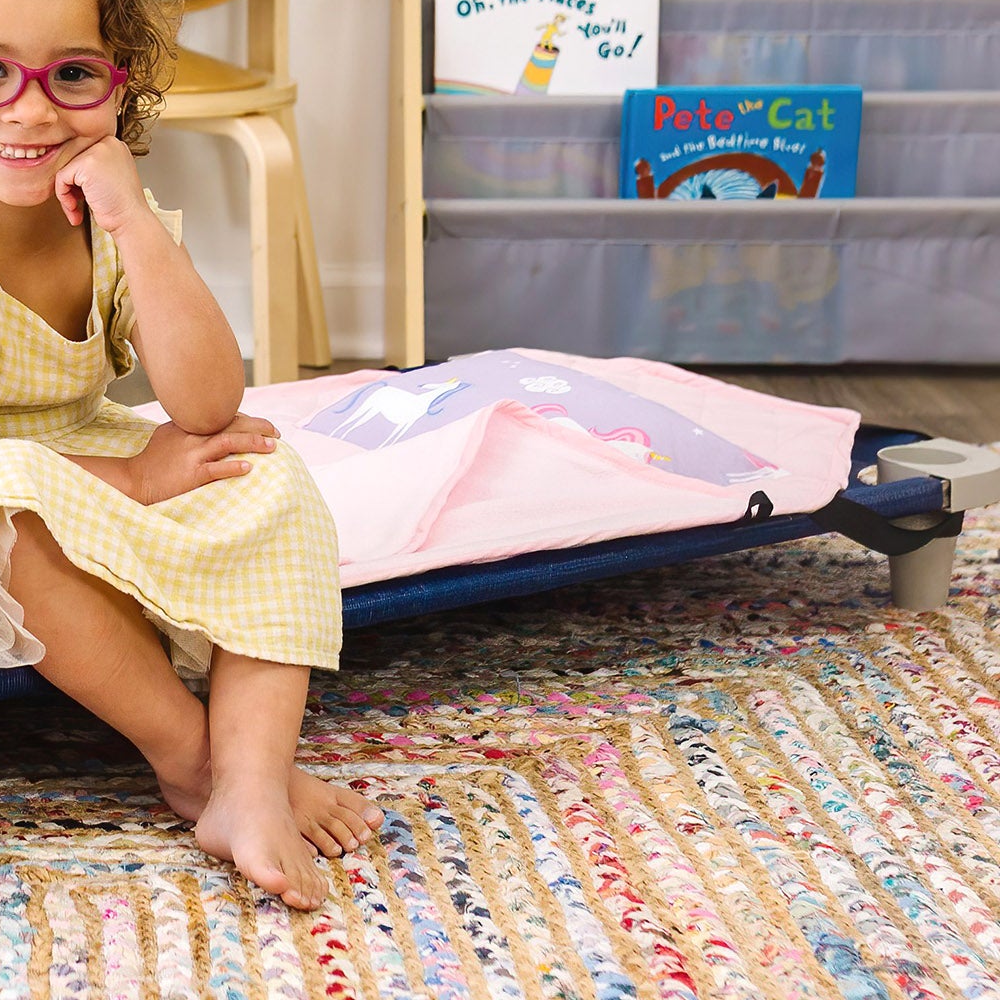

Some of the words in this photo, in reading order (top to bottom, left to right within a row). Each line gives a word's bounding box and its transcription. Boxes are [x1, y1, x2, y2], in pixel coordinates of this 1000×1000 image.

[653, 95, 735, 131] Pete
[737, 99, 764, 115] the
[767, 97, 837, 131] Cat
